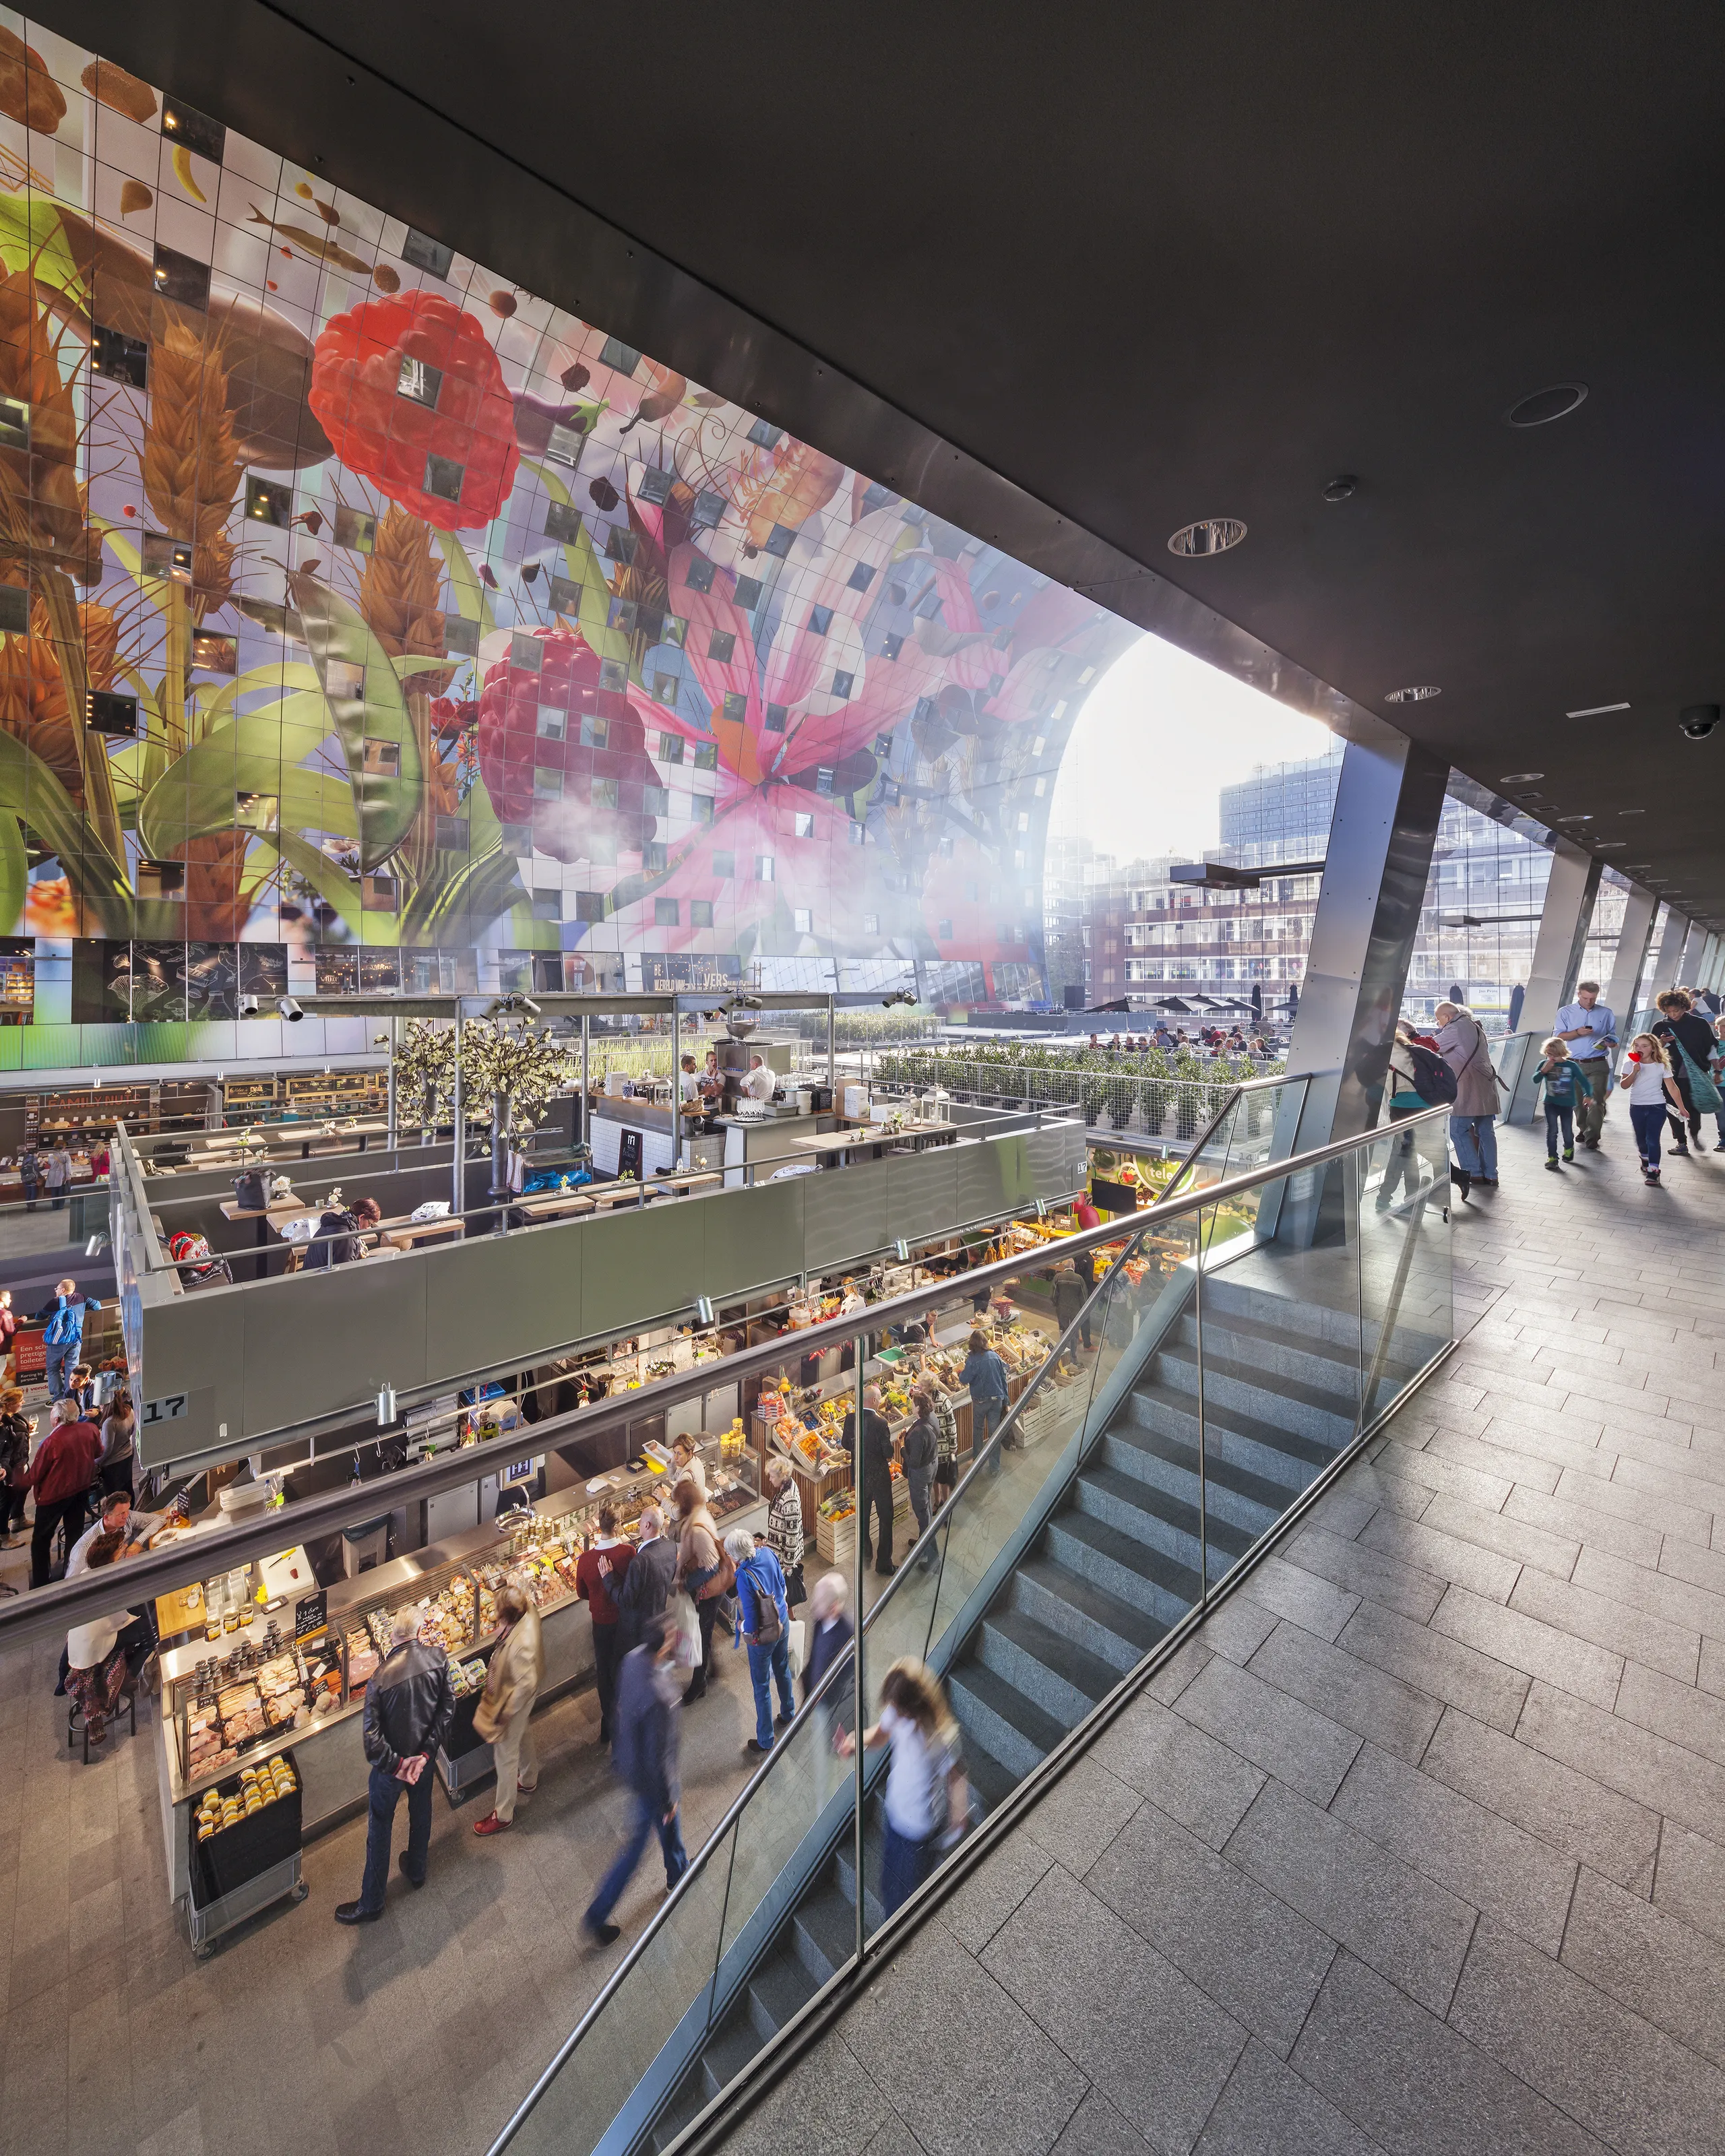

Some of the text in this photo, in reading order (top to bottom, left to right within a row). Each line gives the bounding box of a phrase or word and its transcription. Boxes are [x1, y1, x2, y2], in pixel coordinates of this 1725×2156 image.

[703, 973, 728, 987] VERS
[48, 1093, 141, 1110] FAMILY NUTS
[1078, 1162, 1086, 1173] 17
[1150, 1167, 1174, 1180] tele
[20, 1350, 46, 1360] prettige
[20, 1356, 46, 1364] toileter
[144, 1395, 185, 1424] 17
